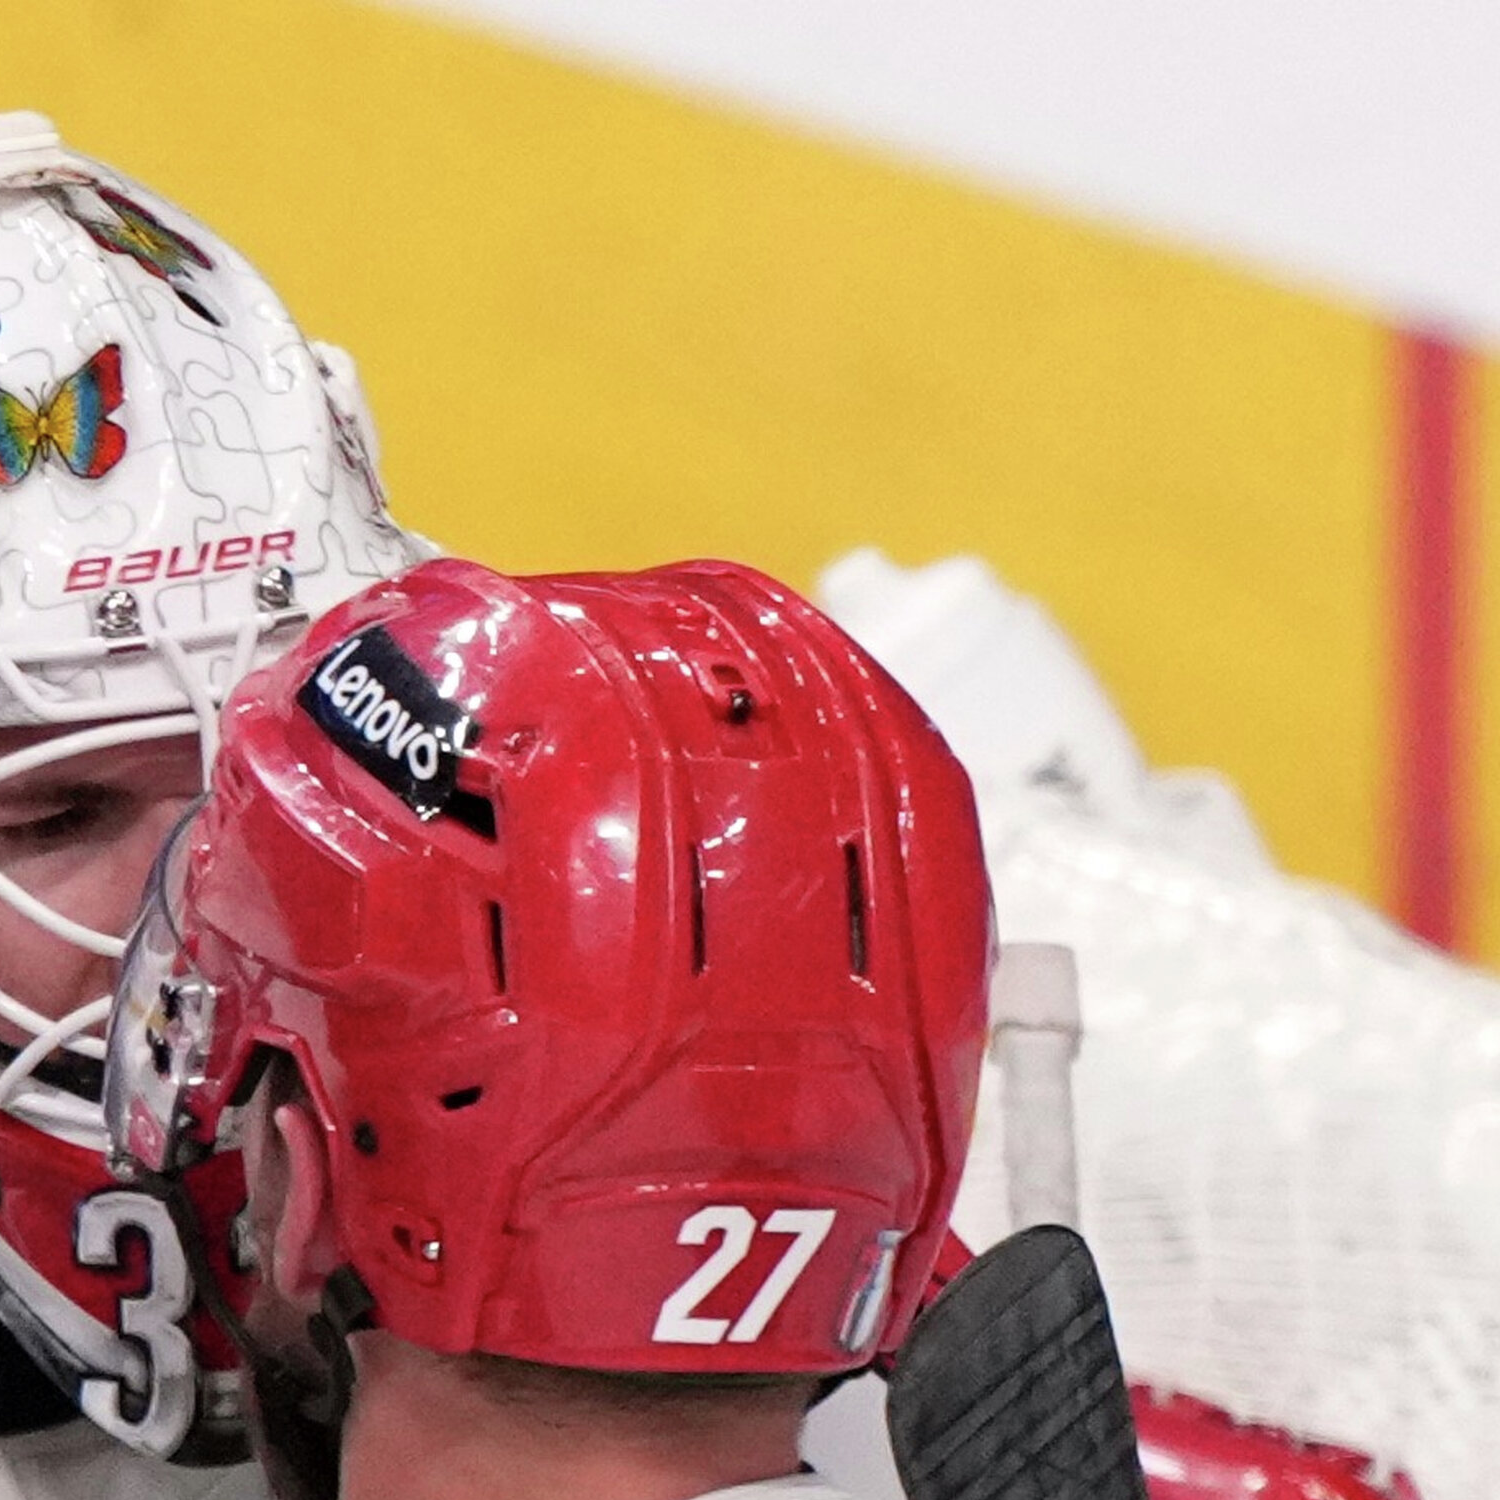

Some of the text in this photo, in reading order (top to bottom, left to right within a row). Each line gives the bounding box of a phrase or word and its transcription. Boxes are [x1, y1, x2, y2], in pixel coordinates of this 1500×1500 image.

[65, 531, 297, 593] BAUER
[316, 638, 439, 781] Lenovo
[652, 1206, 836, 1344] 27
